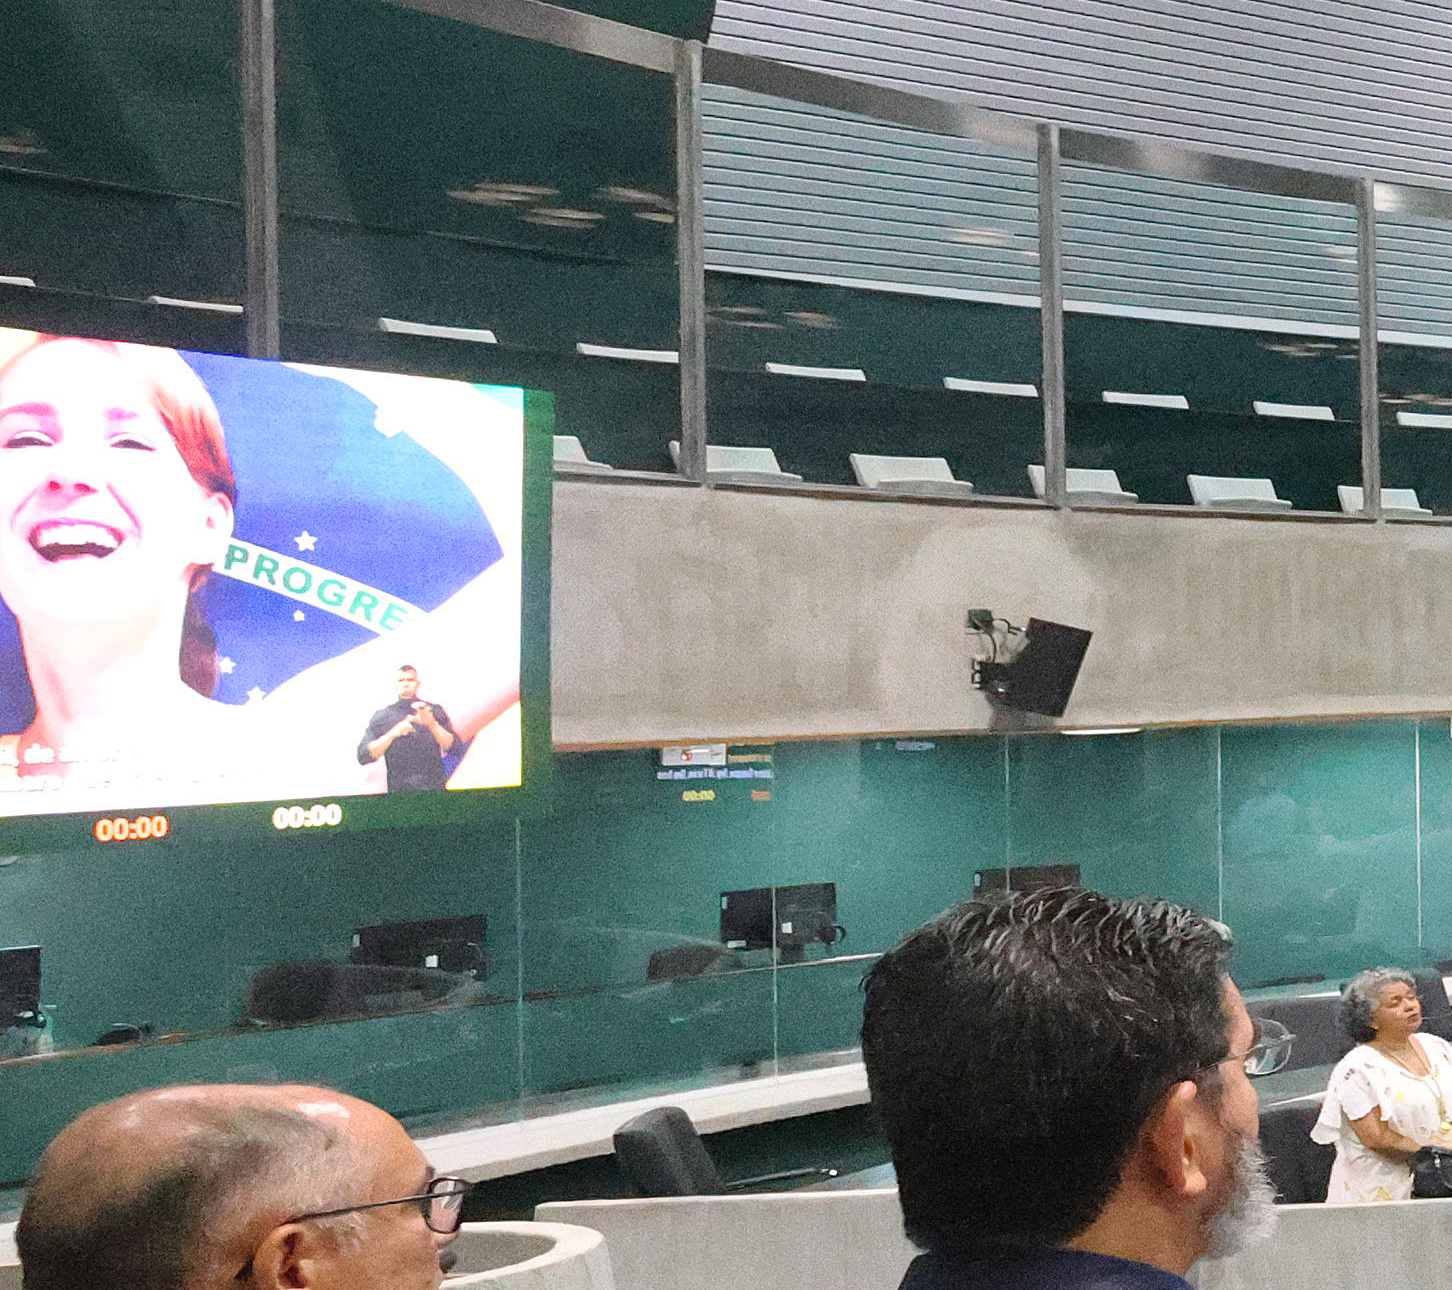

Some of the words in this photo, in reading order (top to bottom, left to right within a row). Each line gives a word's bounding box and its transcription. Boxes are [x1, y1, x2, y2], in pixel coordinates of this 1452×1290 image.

[224, 544, 409, 630] PROGRE
[95, 814, 169, 842] 00:00
[271, 802, 343, 830] 00:00
